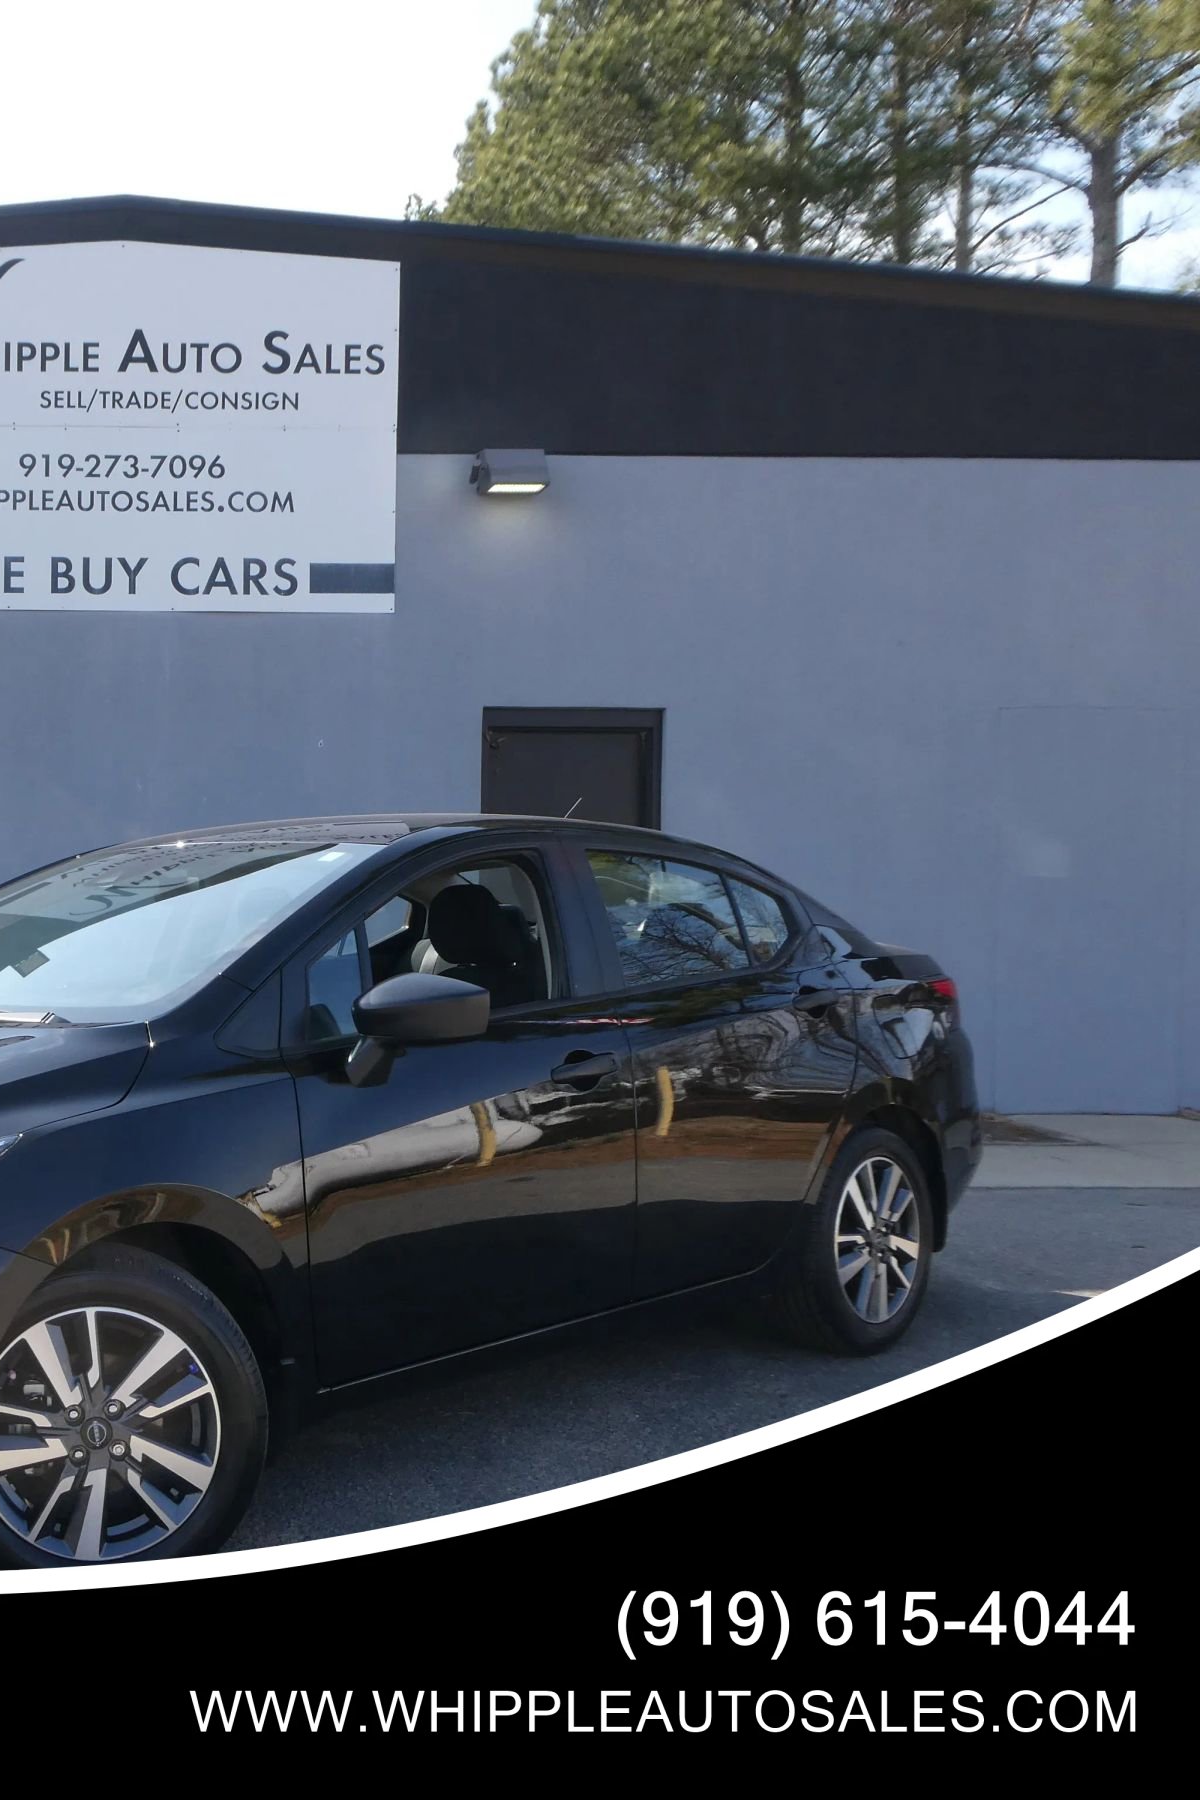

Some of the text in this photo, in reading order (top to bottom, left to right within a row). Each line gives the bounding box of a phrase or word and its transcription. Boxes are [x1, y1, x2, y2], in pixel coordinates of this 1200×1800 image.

[118, 328, 243, 375] AUTO
[262, 330, 386, 375] SALES
[39, 388, 300, 413] SELL/TRADE/CONSIGN
[19, 453, 226, 479] 919-273-7096
[50, 556, 149, 596] BUY
[170, 556, 299, 597] CARS
